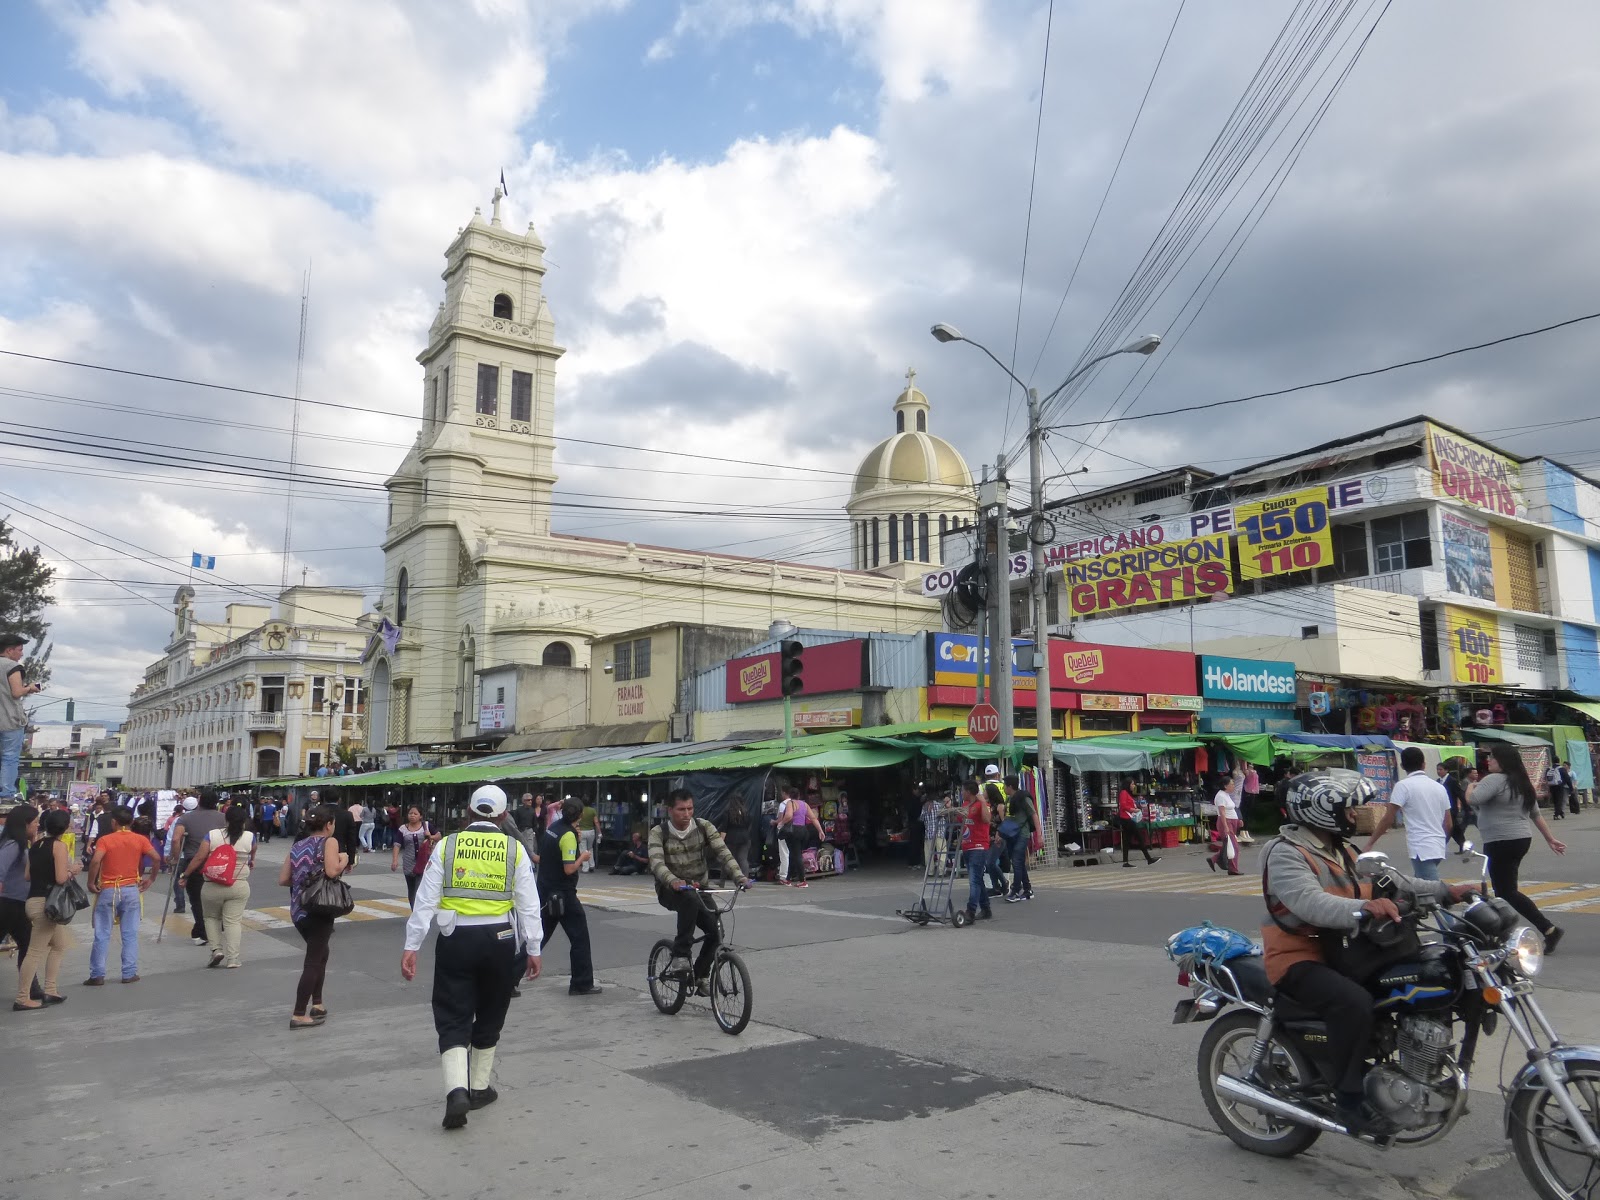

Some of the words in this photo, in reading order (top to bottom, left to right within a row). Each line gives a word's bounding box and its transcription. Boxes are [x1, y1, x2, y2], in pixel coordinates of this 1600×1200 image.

[1434, 433, 1508, 485] INSCRIPCIÓN
[1440, 459, 1516, 516] GRATIS
[1262, 496, 1297, 512] Cuota
[1238, 501, 1327, 545] 150
[1066, 537, 1224, 584] INSCRIPCIÓN
[1252, 541, 1321, 575] 110
[1072, 562, 1229, 613] GRATIS
[1068, 652, 1099, 672] QueDely
[1205, 665, 1295, 694] Holandesa
[617, 684, 644, 702] FARMACIA
[969, 715, 998, 732] ALTO
[457, 838, 506, 849] POLICIA
[456, 849, 505, 862] MUNICIPAL
[478, 882, 504, 890] GUATEMALA
[1304, 1034, 1328, 1043] GN125
